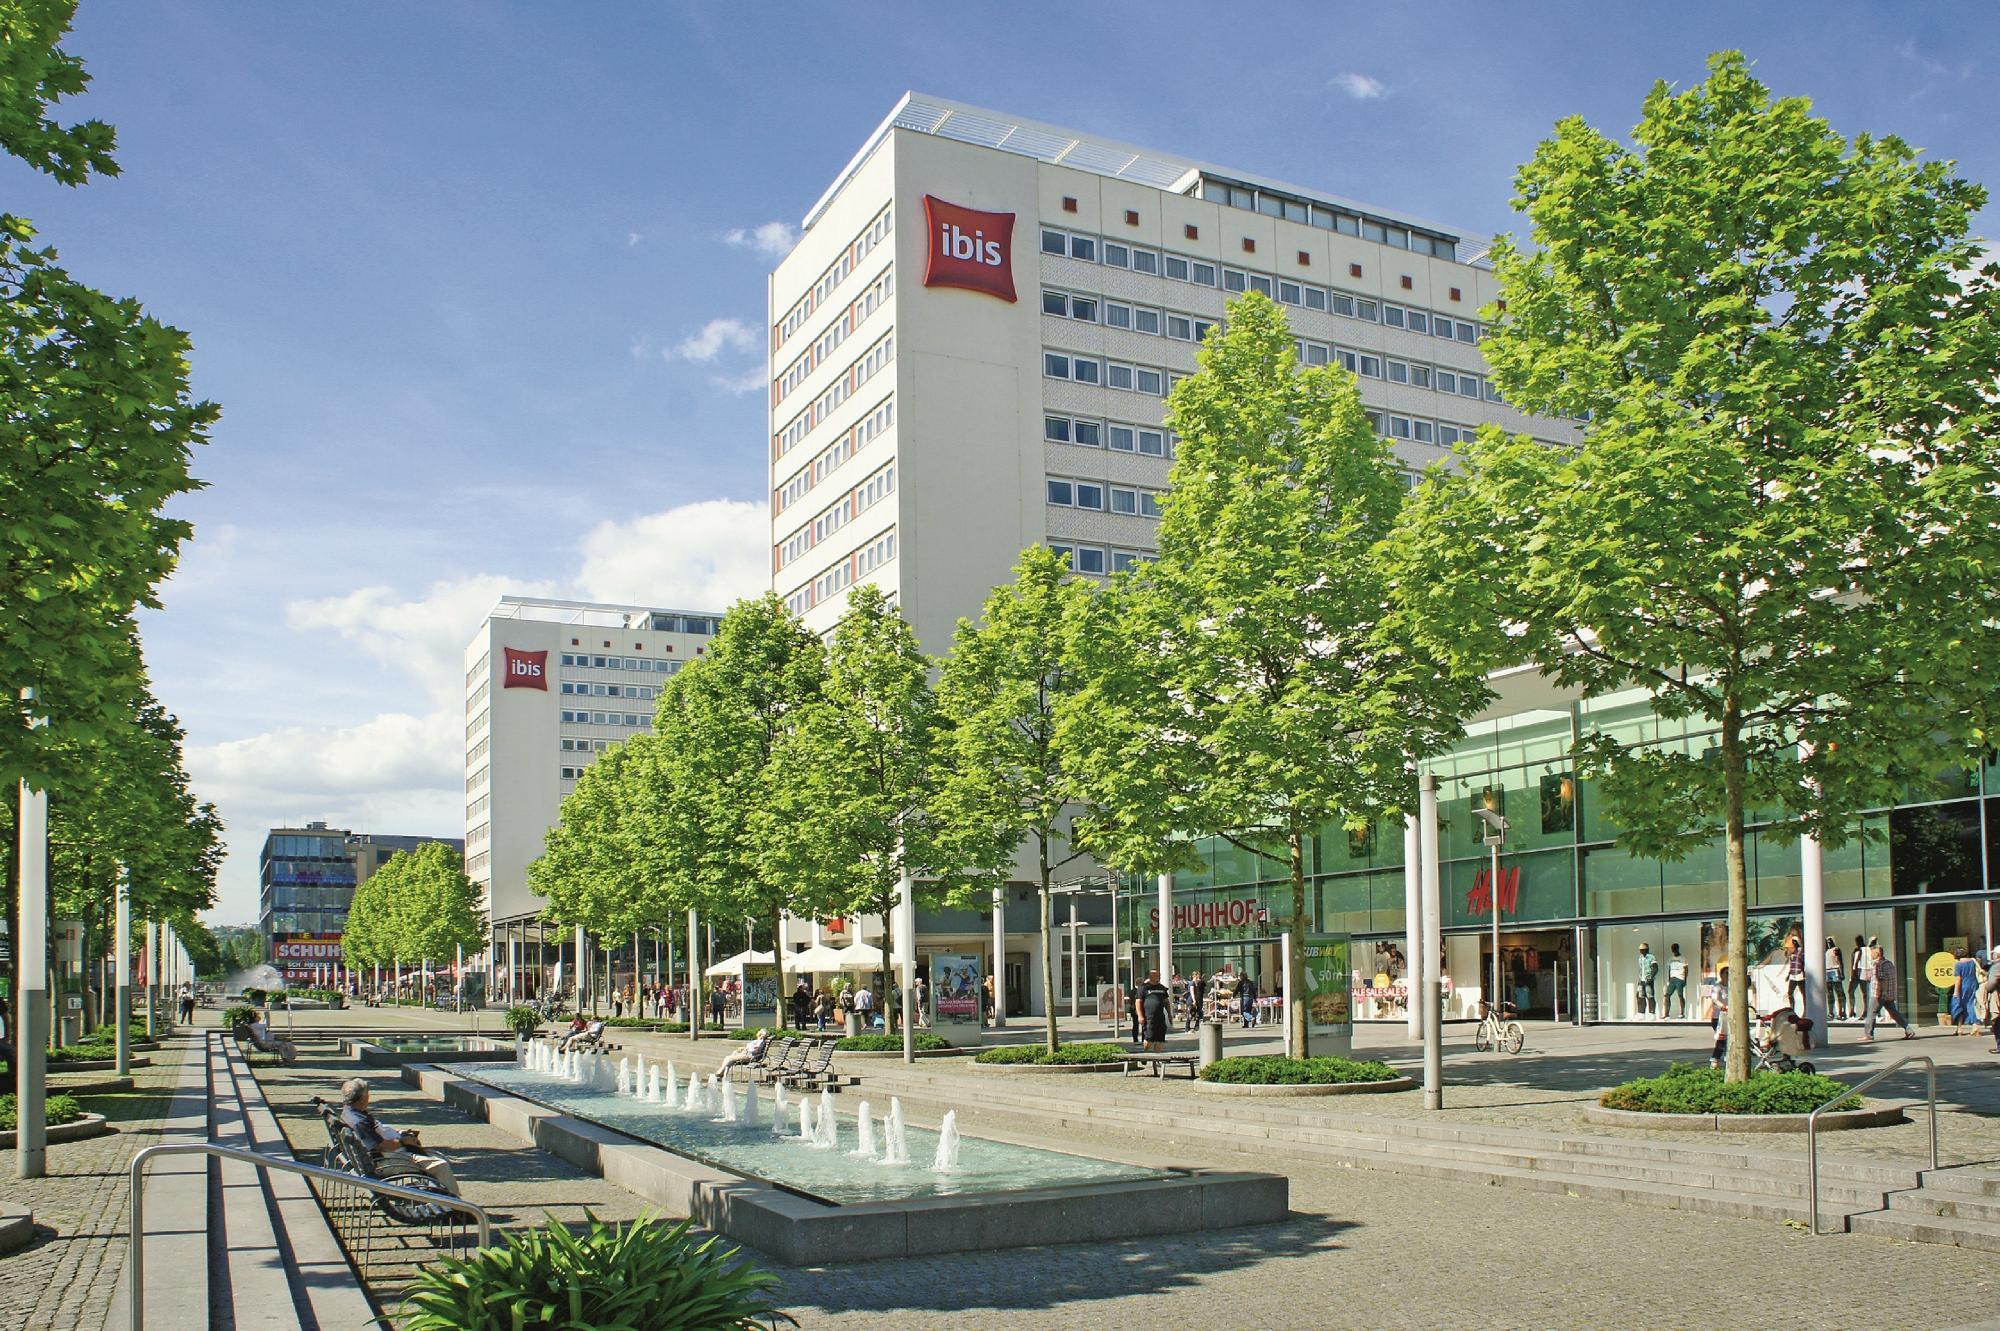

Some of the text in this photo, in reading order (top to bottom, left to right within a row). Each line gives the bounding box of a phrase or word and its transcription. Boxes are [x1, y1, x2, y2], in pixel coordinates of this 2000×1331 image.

[942, 223, 1002, 266] ibis
[512, 659, 541, 676] ibis
[1150, 899, 1257, 932] SHUHHOF
[1319, 971, 1332, 981] 50
[1934, 967, 1953, 977] 25€
[1365, 988, 1384, 997] SALE
[1383, 987, 1401, 997] SALE
